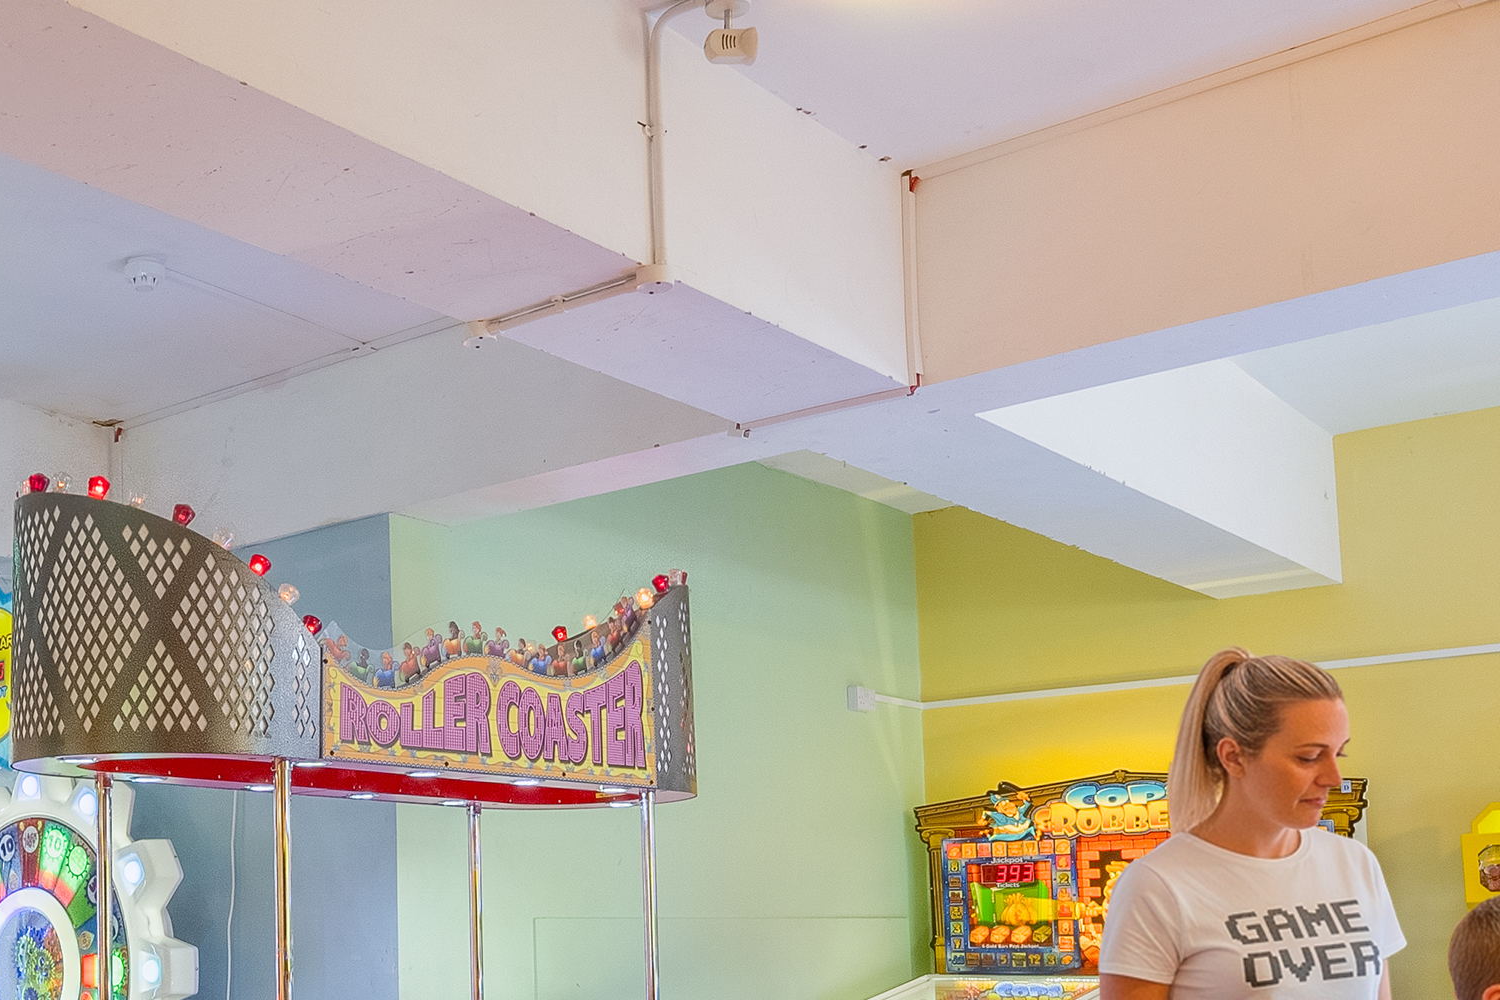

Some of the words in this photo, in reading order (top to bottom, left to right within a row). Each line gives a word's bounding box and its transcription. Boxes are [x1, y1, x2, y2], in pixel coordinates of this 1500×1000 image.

[339, 672, 491, 756] ROLLER
[499, 660, 647, 769] COASTER
[1065, 784, 1169, 809] COP
[1050, 799, 1170, 837] ROBBE
[1, 838, 14, 857] 10
[49, 835, 61, 852] 10
[996, 865, 1034, 882] 393
[1225, 899, 1369, 945] GAME
[1243, 940, 1381, 988] OVER
